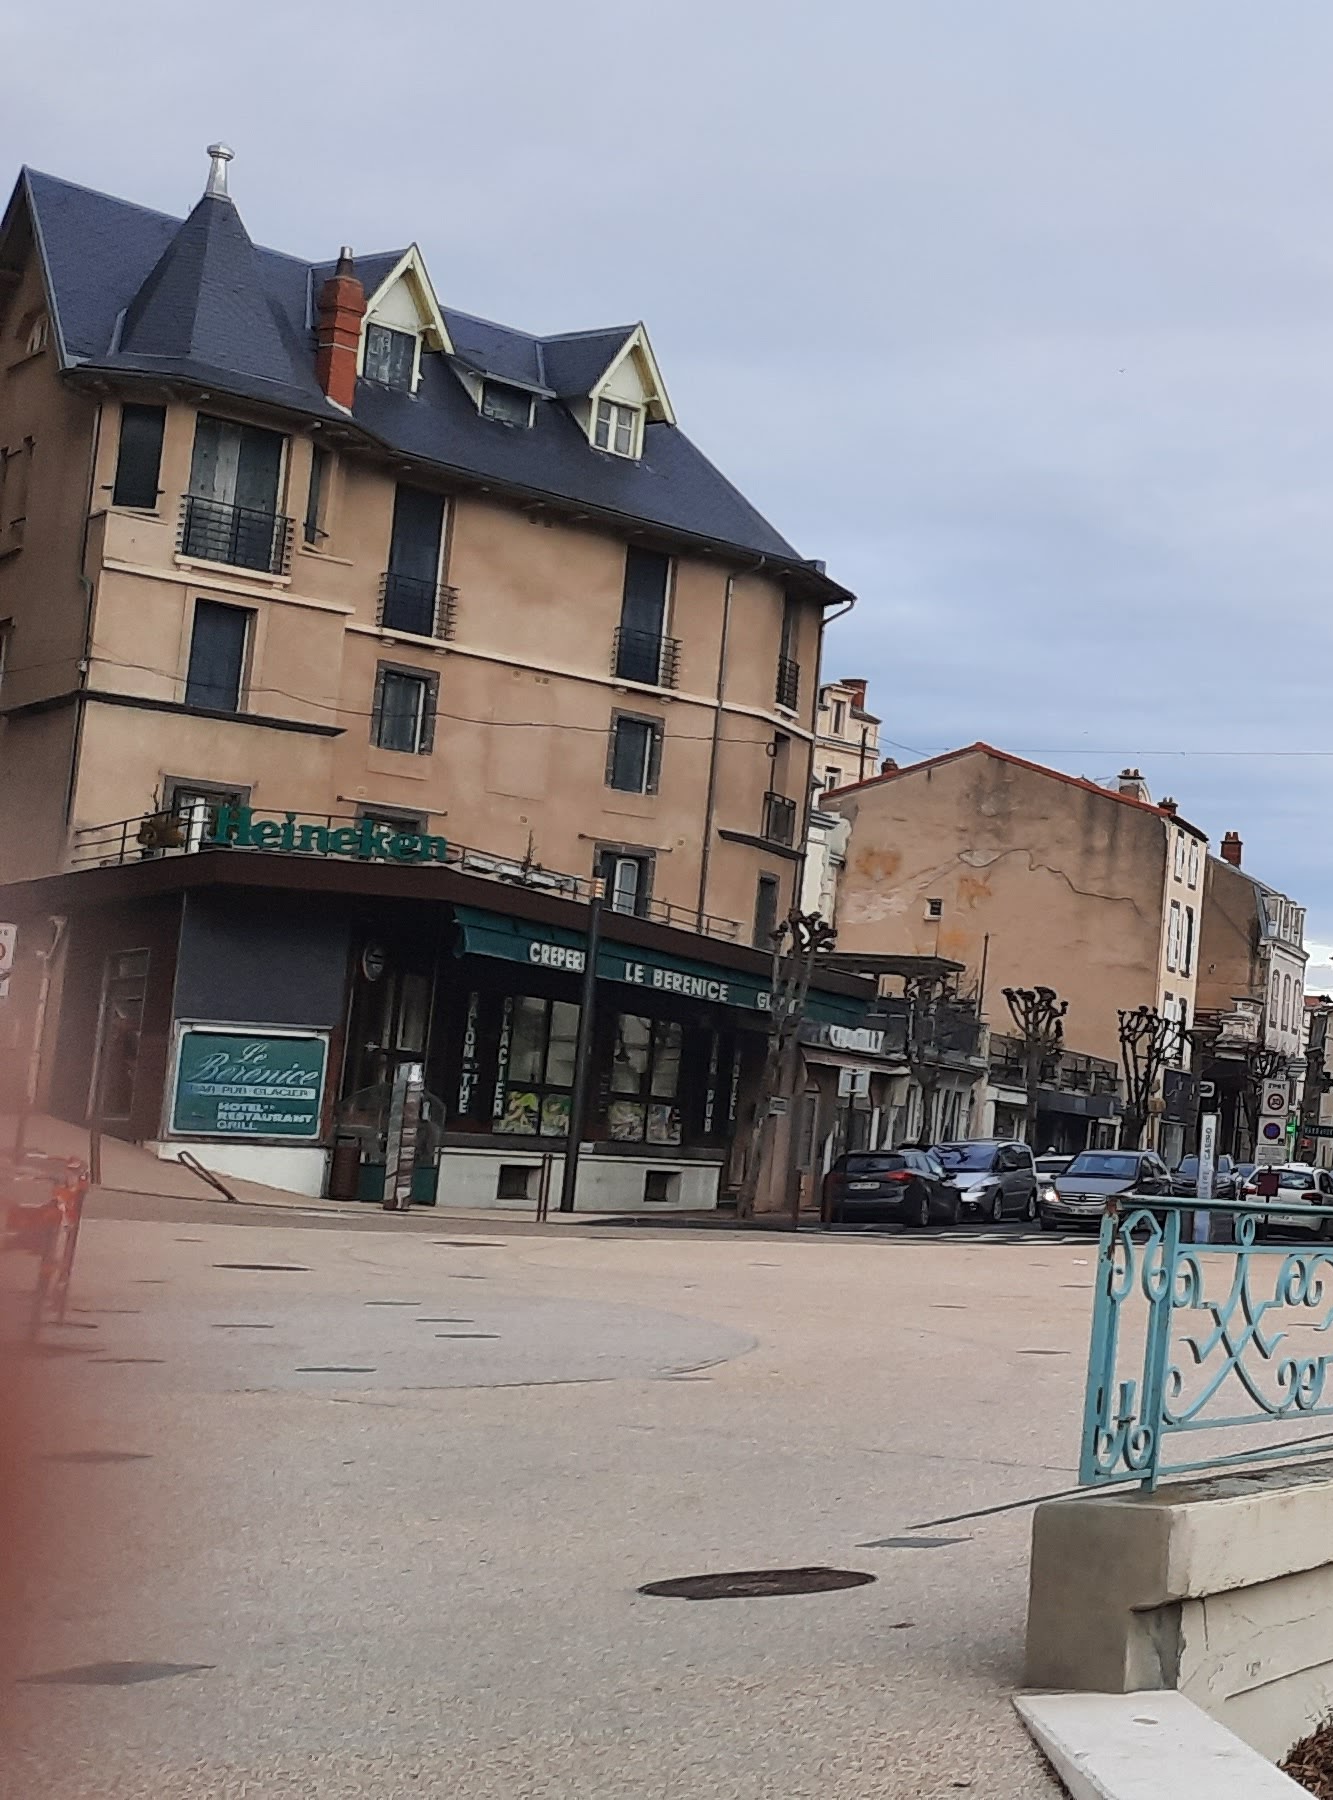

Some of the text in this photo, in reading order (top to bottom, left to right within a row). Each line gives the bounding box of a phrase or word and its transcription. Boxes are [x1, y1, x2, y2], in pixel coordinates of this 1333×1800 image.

[215, 803, 448, 862] Heineken
[529, 942, 586, 974] CREPERI
[624, 961, 729, 1001] LE BERENICE
[233, 1042, 270, 1065] Le
[217, 1111, 315, 1124] RESTAURANT
